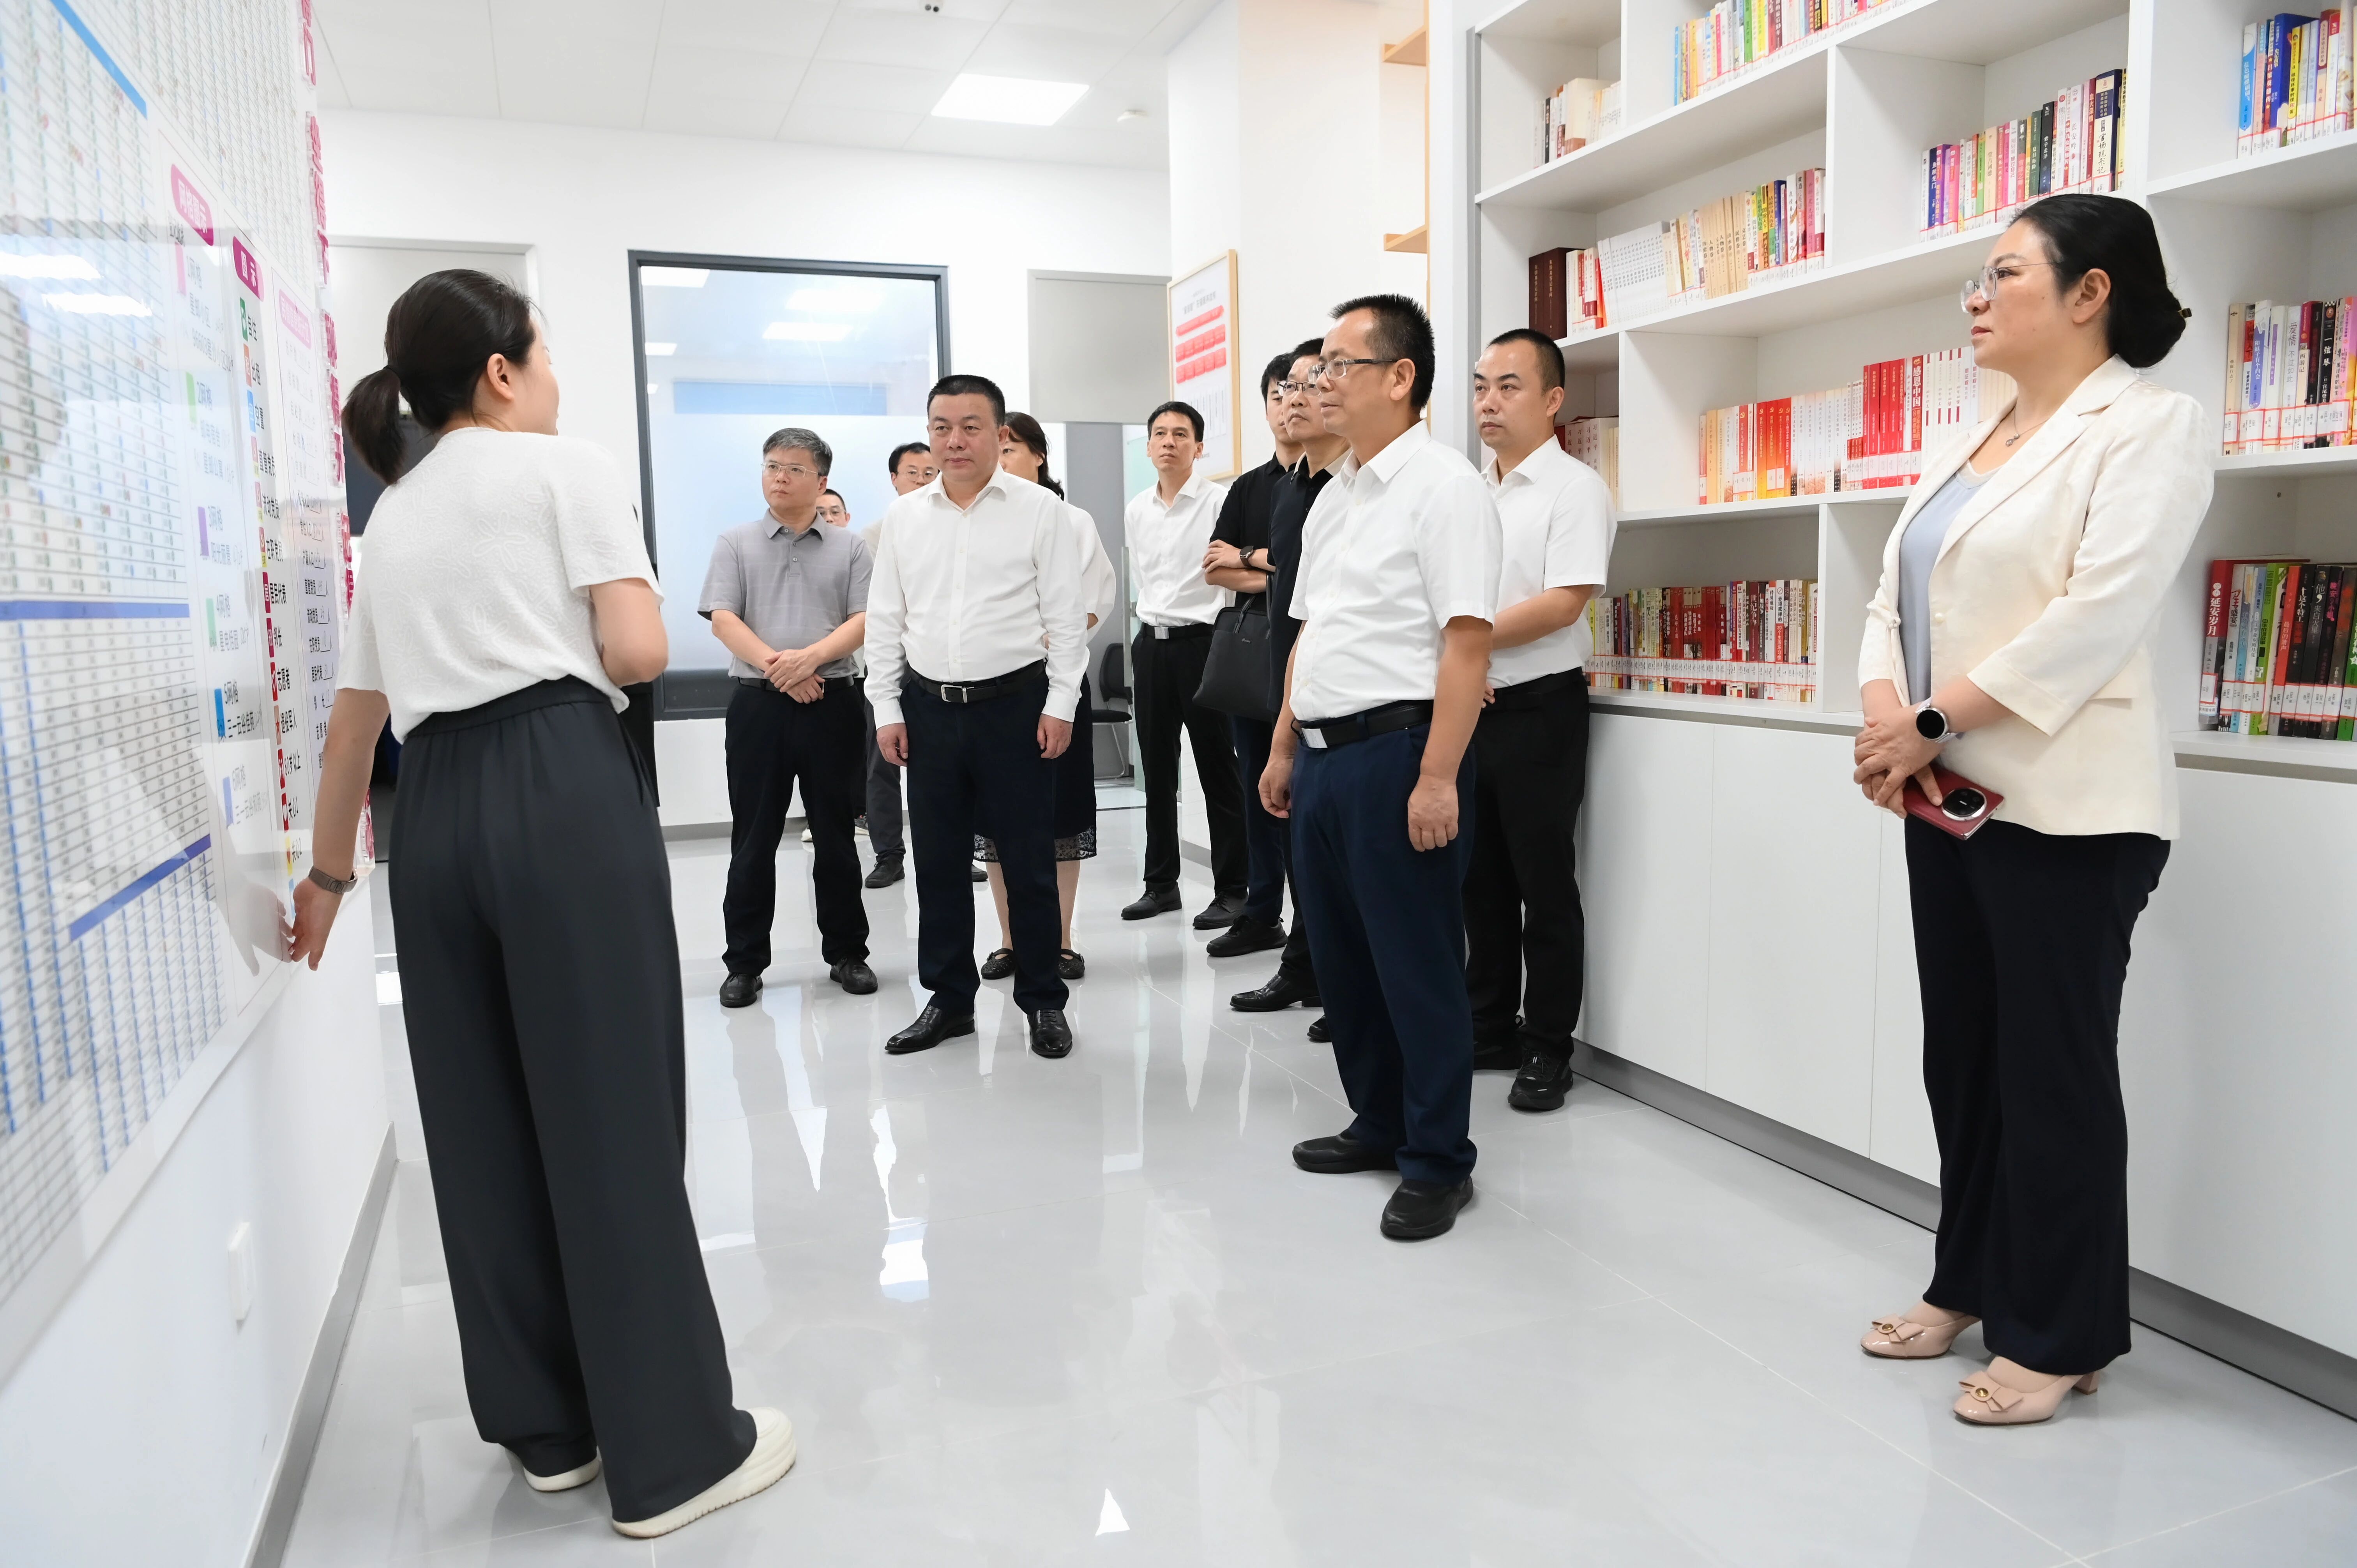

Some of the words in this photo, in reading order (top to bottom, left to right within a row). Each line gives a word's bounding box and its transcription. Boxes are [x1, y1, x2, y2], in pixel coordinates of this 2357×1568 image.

[2097, 133, 2107, 174] 官场现形记
[2323, 338, 2332, 367] 一弦琴
[251, 358, 261, 386] 出租
[1913, 365, 1922, 408] 感恩中国
[254, 403, 265, 429] 空置
[262, 492, 280, 520] 流动党员
[266, 538, 284, 562] 在职党员
[216, 593, 231, 618] 4网格
[270, 583, 287, 604] 居民代表
[307, 607, 318, 624] 流动党员
[2207, 598, 2221, 636] 延安岁月
[309, 636, 321, 657] 在职党员
[277, 667, 290, 692] 志愿者
[312, 665, 323, 682] 居民代表
[224, 678, 239, 705] 5网格
[280, 708, 298, 734] 退役军人
[284, 749, 301, 776] 80岁以上
[288, 796, 299, 821] 关心1
[292, 838, 302, 864] 关心2
